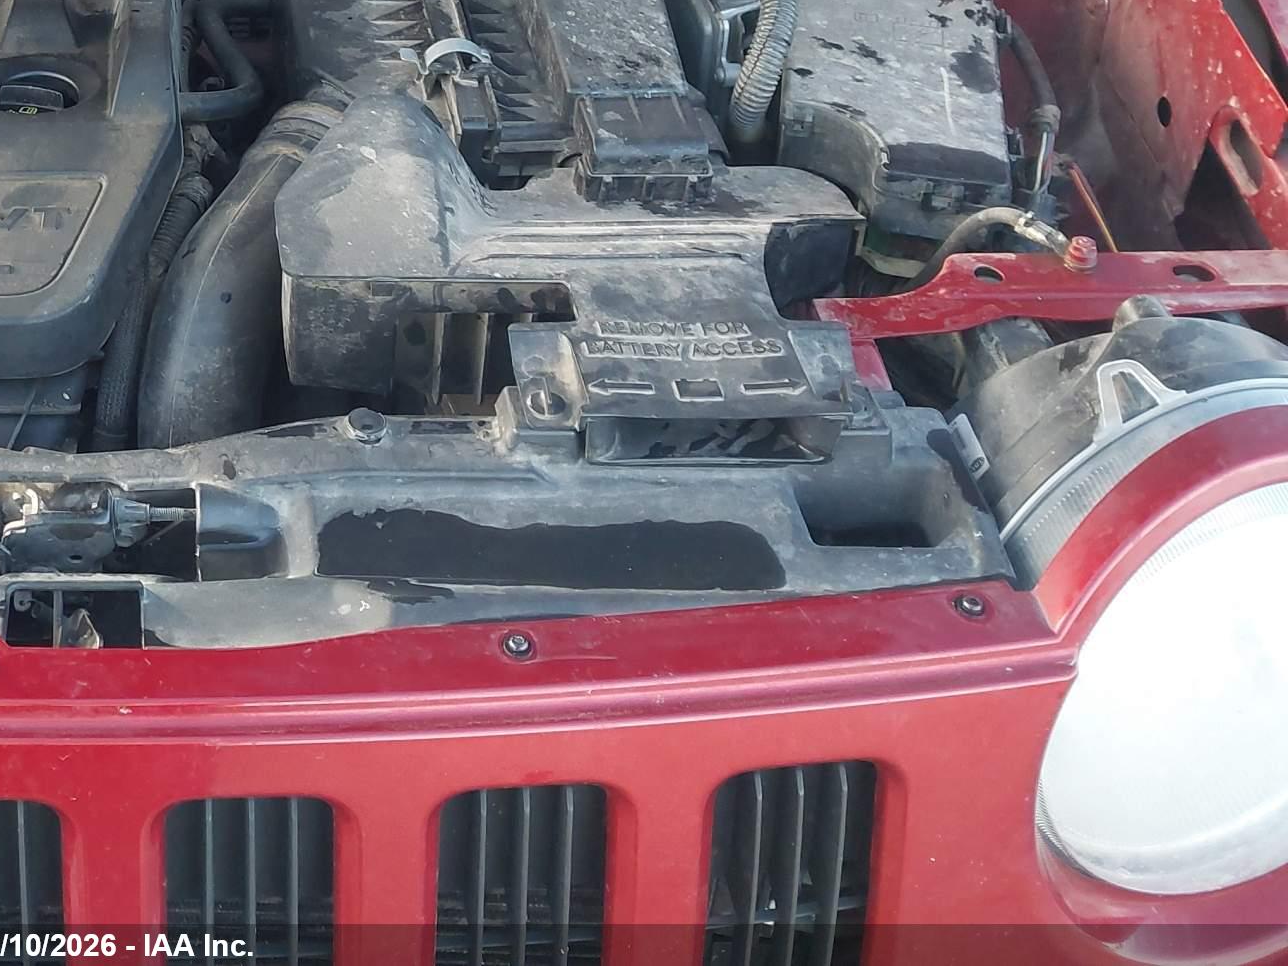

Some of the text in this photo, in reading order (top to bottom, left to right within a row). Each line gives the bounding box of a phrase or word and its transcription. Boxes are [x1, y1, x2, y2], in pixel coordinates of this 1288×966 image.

[595, 321, 751, 337] REMOVE FOR
[583, 339, 784, 359] BATTERY ACCESS
